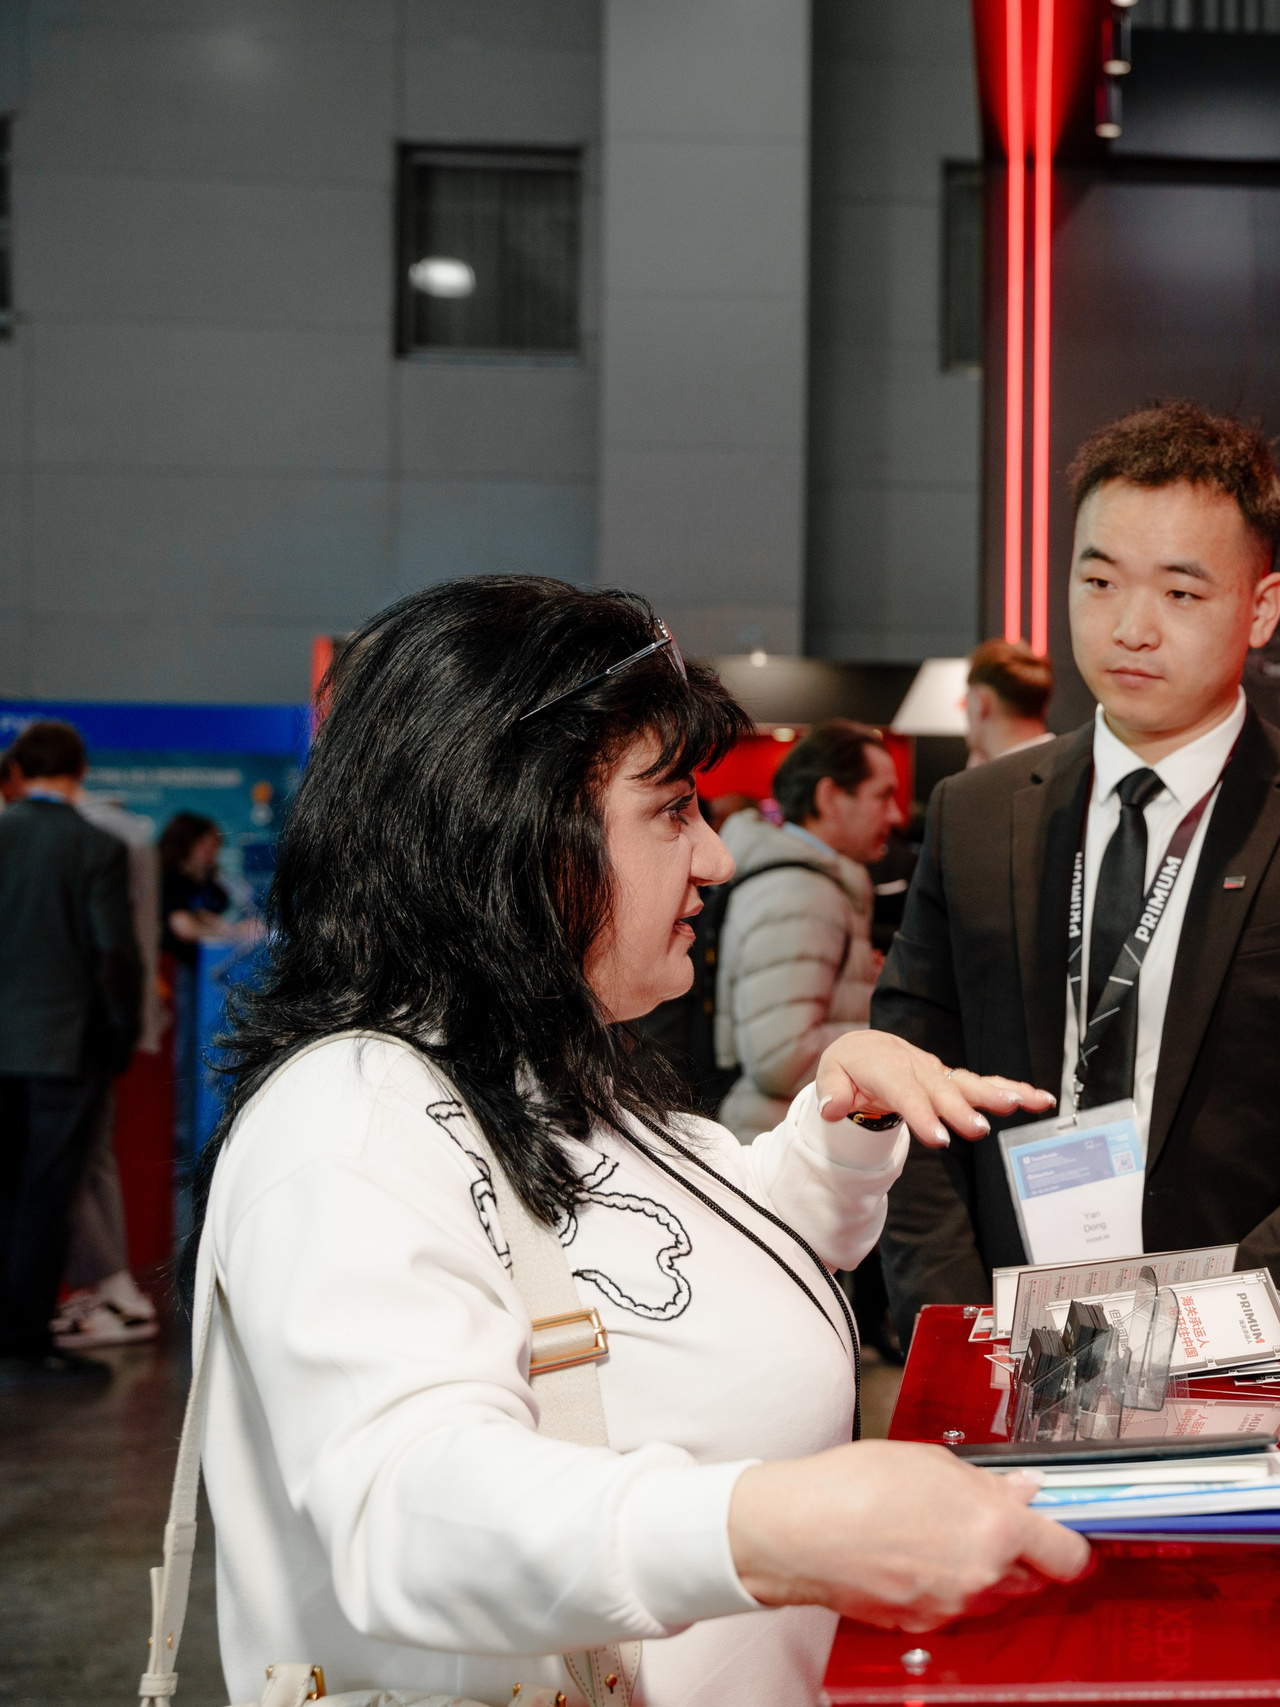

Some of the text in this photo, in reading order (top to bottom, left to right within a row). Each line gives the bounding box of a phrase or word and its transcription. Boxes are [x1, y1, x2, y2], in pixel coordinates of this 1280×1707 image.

[1134, 855, 1183, 944] PRIMUM
[1083, 1221, 1107, 1233] Dong
[1180, 1296, 1211, 1348] 海关承运人
[1236, 1292, 1266, 1344] PRIMUM
